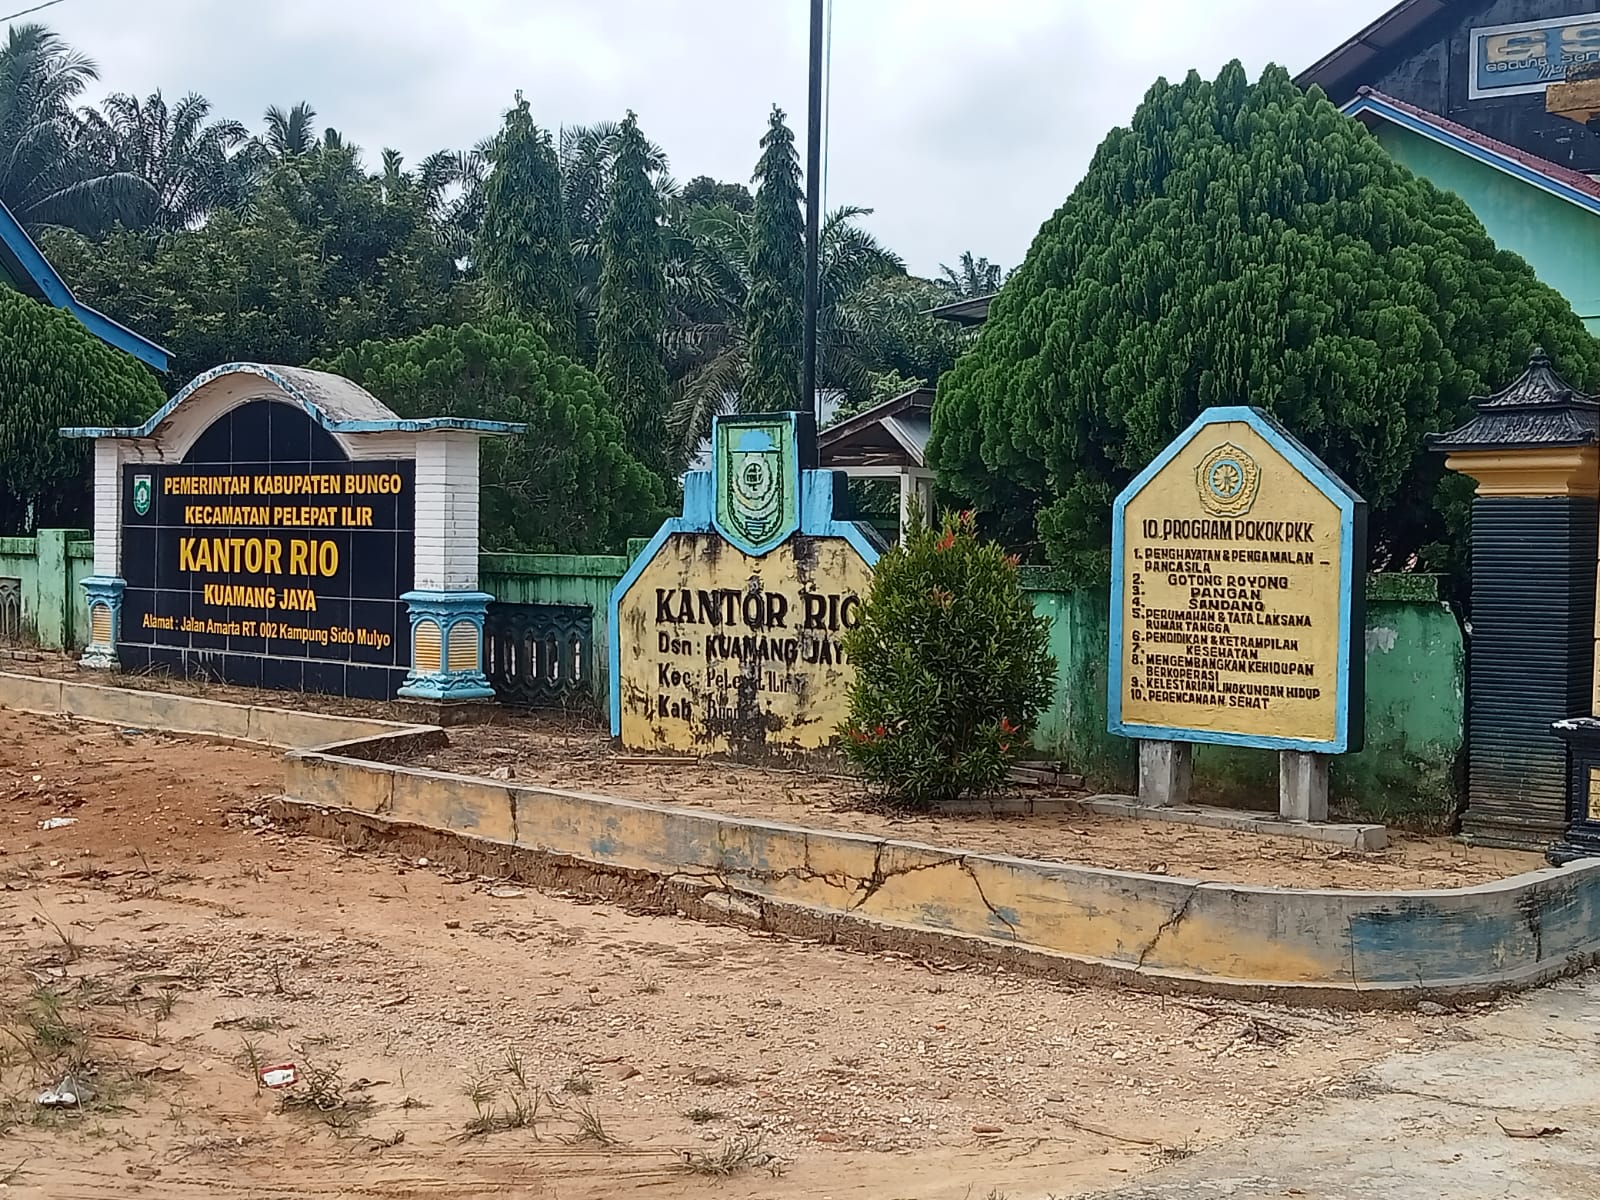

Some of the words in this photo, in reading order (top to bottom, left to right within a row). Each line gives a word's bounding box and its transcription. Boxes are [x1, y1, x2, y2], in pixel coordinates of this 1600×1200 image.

[164, 476, 250, 495] PEMERINTAH
[254, 475, 340, 495] KABUPATEN
[345, 474, 402, 494] BUNGO
[185, 505, 270, 526] KECAMATAN
[273, 506, 337, 526] PELEPAT
[341, 507, 373, 526] ILIR
[1234, 520, 1284, 541] POKOK
[1285, 521, 1314, 542] PKK
[179, 537, 283, 574] KANTOR
[289, 540, 340, 577] RIO
[1144, 548, 1221, 561] PENGHAYATAN
[1231, 550, 1314, 564] PENGAMALAN
[1144, 561, 1211, 573] PANCASILA
[1167, 574, 1222, 586] GOTONG
[1226, 575, 1288, 589] ROYONG
[204, 584, 276, 609] KUAMANG
[279, 588, 317, 612] JAYA
[1190, 587, 1261, 600] PANGAN
[655, 588, 788, 631] KANTOR
[1227, 612, 1254, 624] TATA
[1256, 613, 1312, 627] LAKSANA
[142, 613, 174, 630] Alamat
[180, 616, 205, 633] Jalan
[206, 618, 240, 635] Amarta
[242, 621, 258, 637] RT.
[259, 622, 278, 638] 002
[279, 623, 328, 646] Kampung
[330, 626, 355, 644] Sido
[357, 628, 391, 650] Mulyo
[1145, 620, 1183, 631] RUMAH
[1185, 622, 1230, 634] TANGGA
[705, 634, 798, 664] KUAMANG
[802, 639, 852, 665] JAY
[1186, 645, 1258, 660] KESEHATAN
[1146, 654, 1246, 673] MENGEMBANGKAN
[1248, 660, 1315, 676] KEHIDUPAN
[1146, 666, 1219, 682] BERKOPERASI
[1146, 677, 1215, 693] KELESTARIAN
[1286, 687, 1321, 700] HIDUP
[1148, 690, 1225, 705] PERENCANAAN
[1228, 695, 1270, 709] SEHAT
